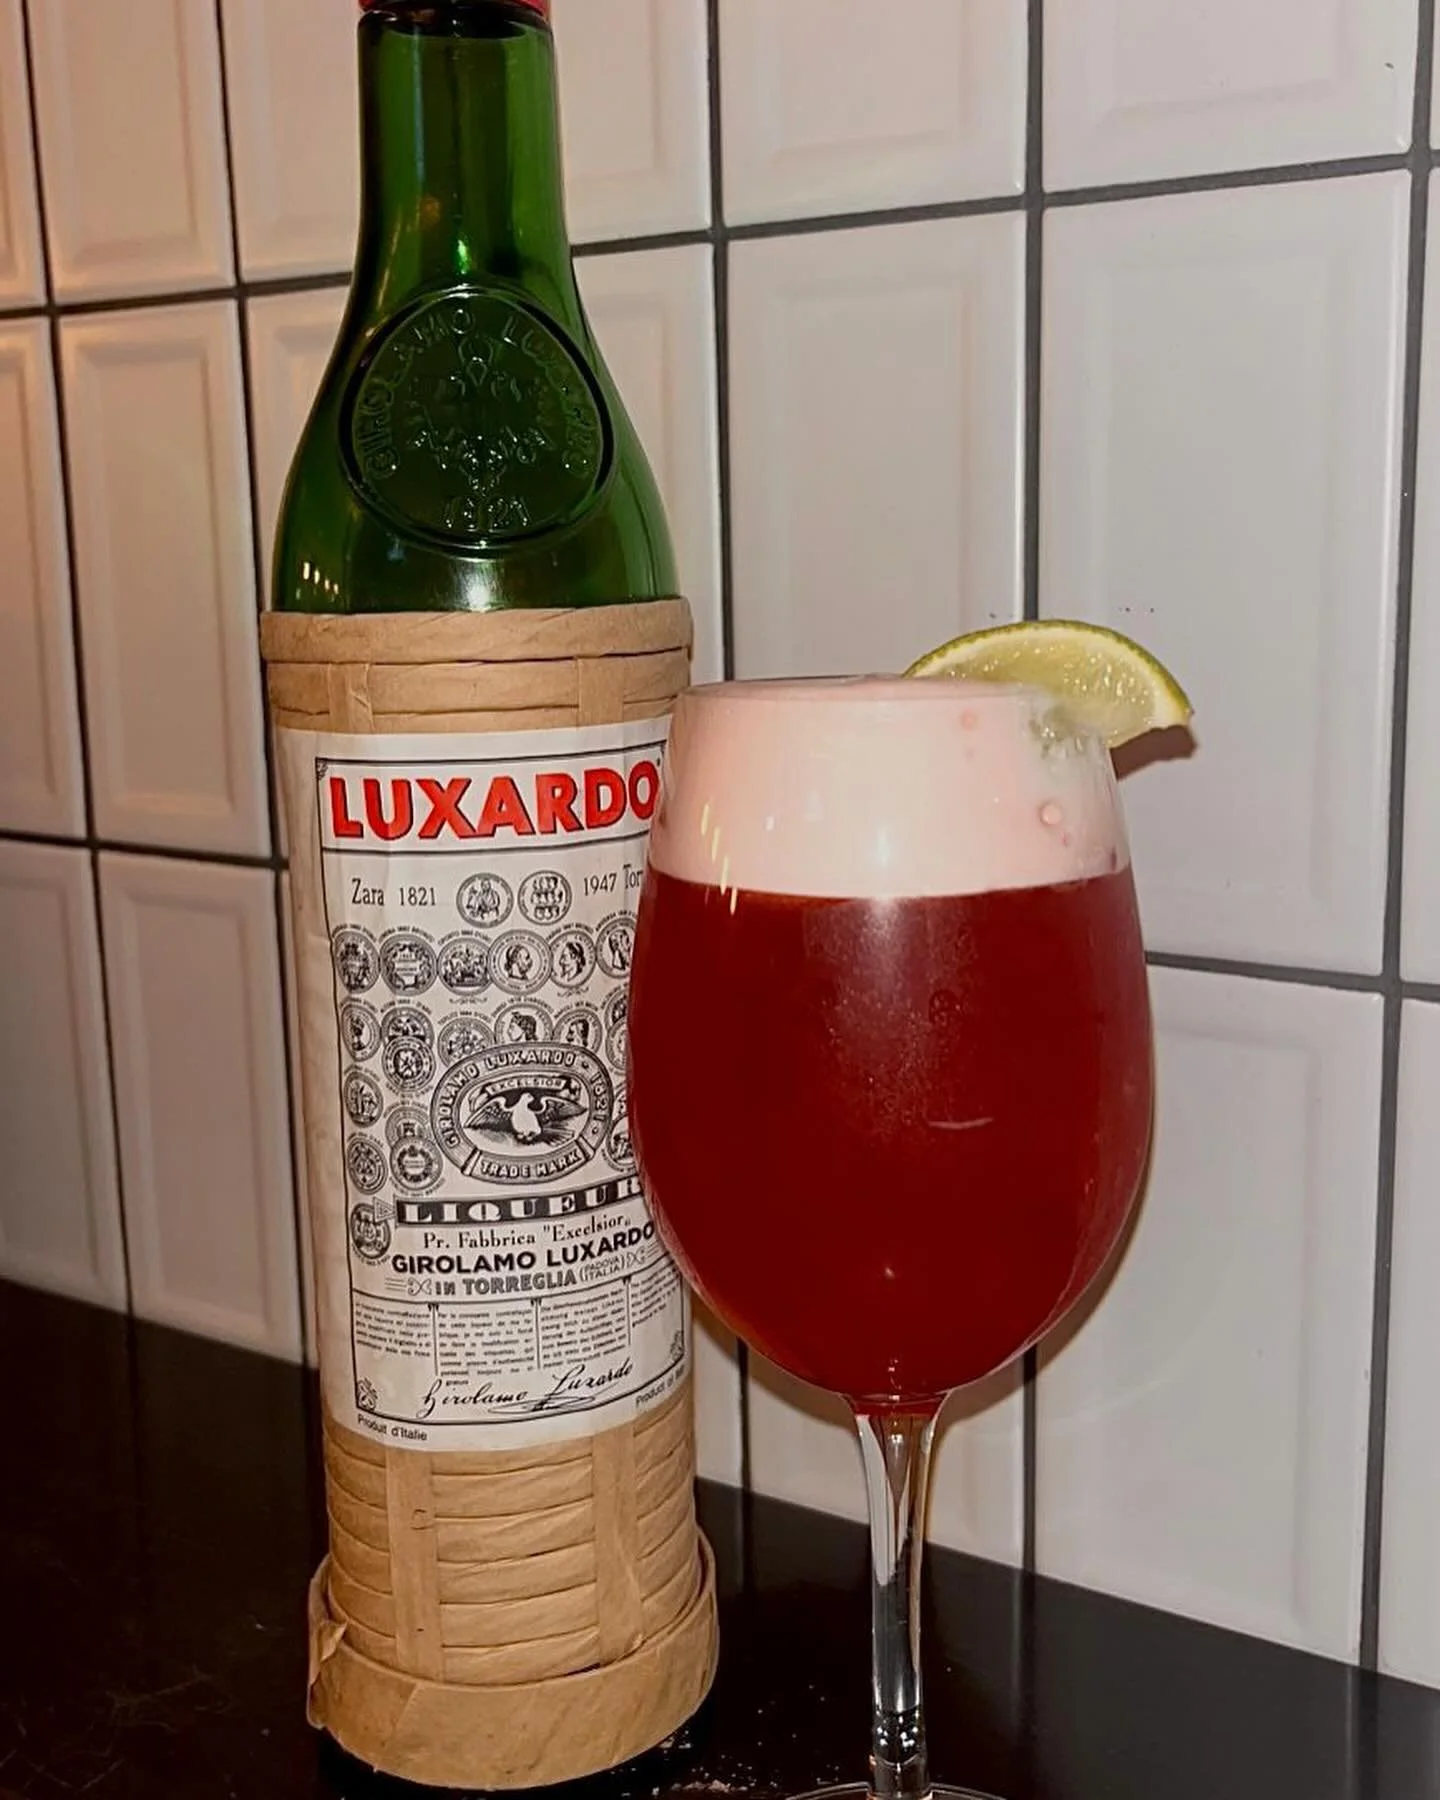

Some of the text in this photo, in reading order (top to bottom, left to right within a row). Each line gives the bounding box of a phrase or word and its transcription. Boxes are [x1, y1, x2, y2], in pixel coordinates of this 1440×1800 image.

[329, 760, 660, 840] LUXARDO
[351, 877, 436, 906] Zara 1821
[583, 872, 617, 896] 1947
[438, 1063, 480, 1148] GIROLAMO
[484, 1049, 577, 1070] LUXARDO
[487, 1077, 562, 1096] EXCELSIOR
[480, 1150, 581, 1178] TRADE MARK
[391, 1251, 537, 1275] GIROLAMO
[547, 1220, 655, 1267] LUXARDO
[423, 1232, 450, 1249] Pr.
[458, 1228, 536, 1249] Fabbrica
[462, 1268, 577, 1295] TORREGLIA
